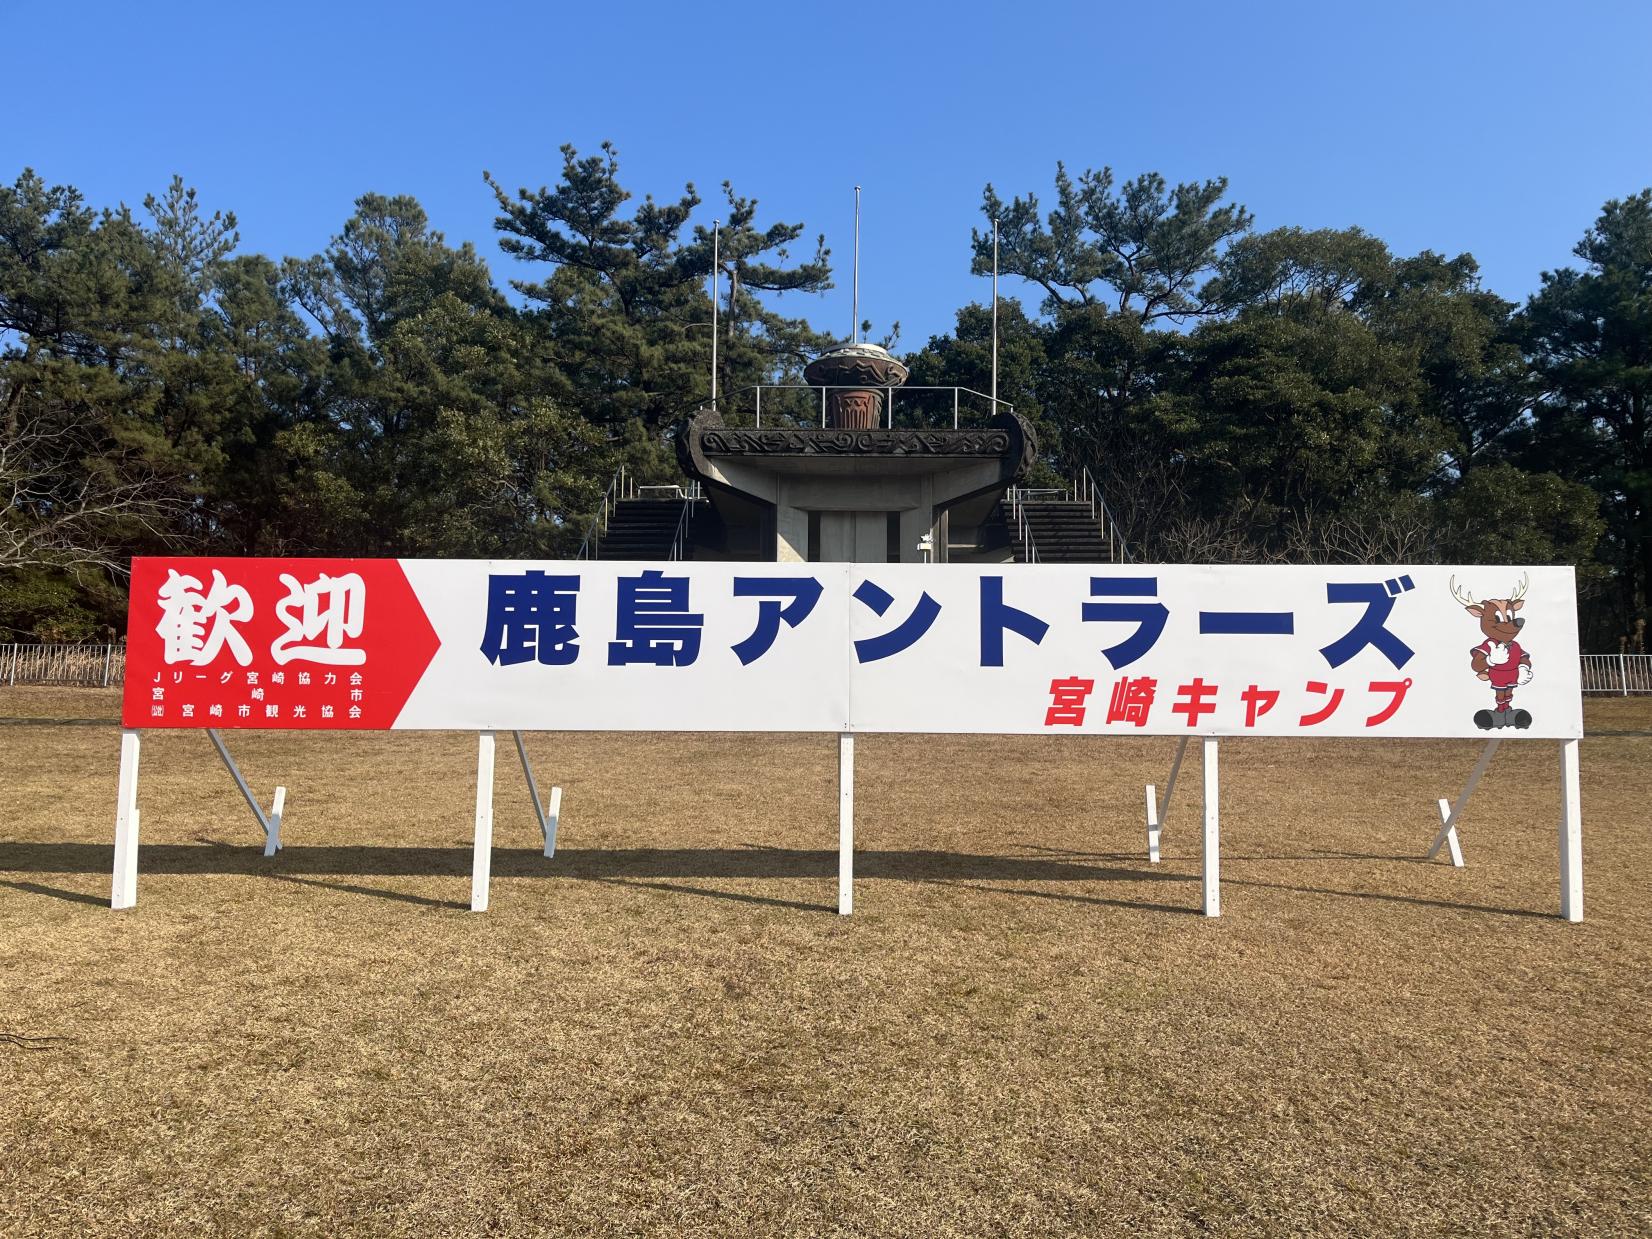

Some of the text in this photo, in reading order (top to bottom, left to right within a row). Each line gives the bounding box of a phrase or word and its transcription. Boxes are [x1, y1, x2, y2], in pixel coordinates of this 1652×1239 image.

[156, 569, 366, 666] 歓迎
[482, 571, 1413, 668] 鹿島アントラーズ
[1045, 675, 1412, 727] 宮崎キャンプ
